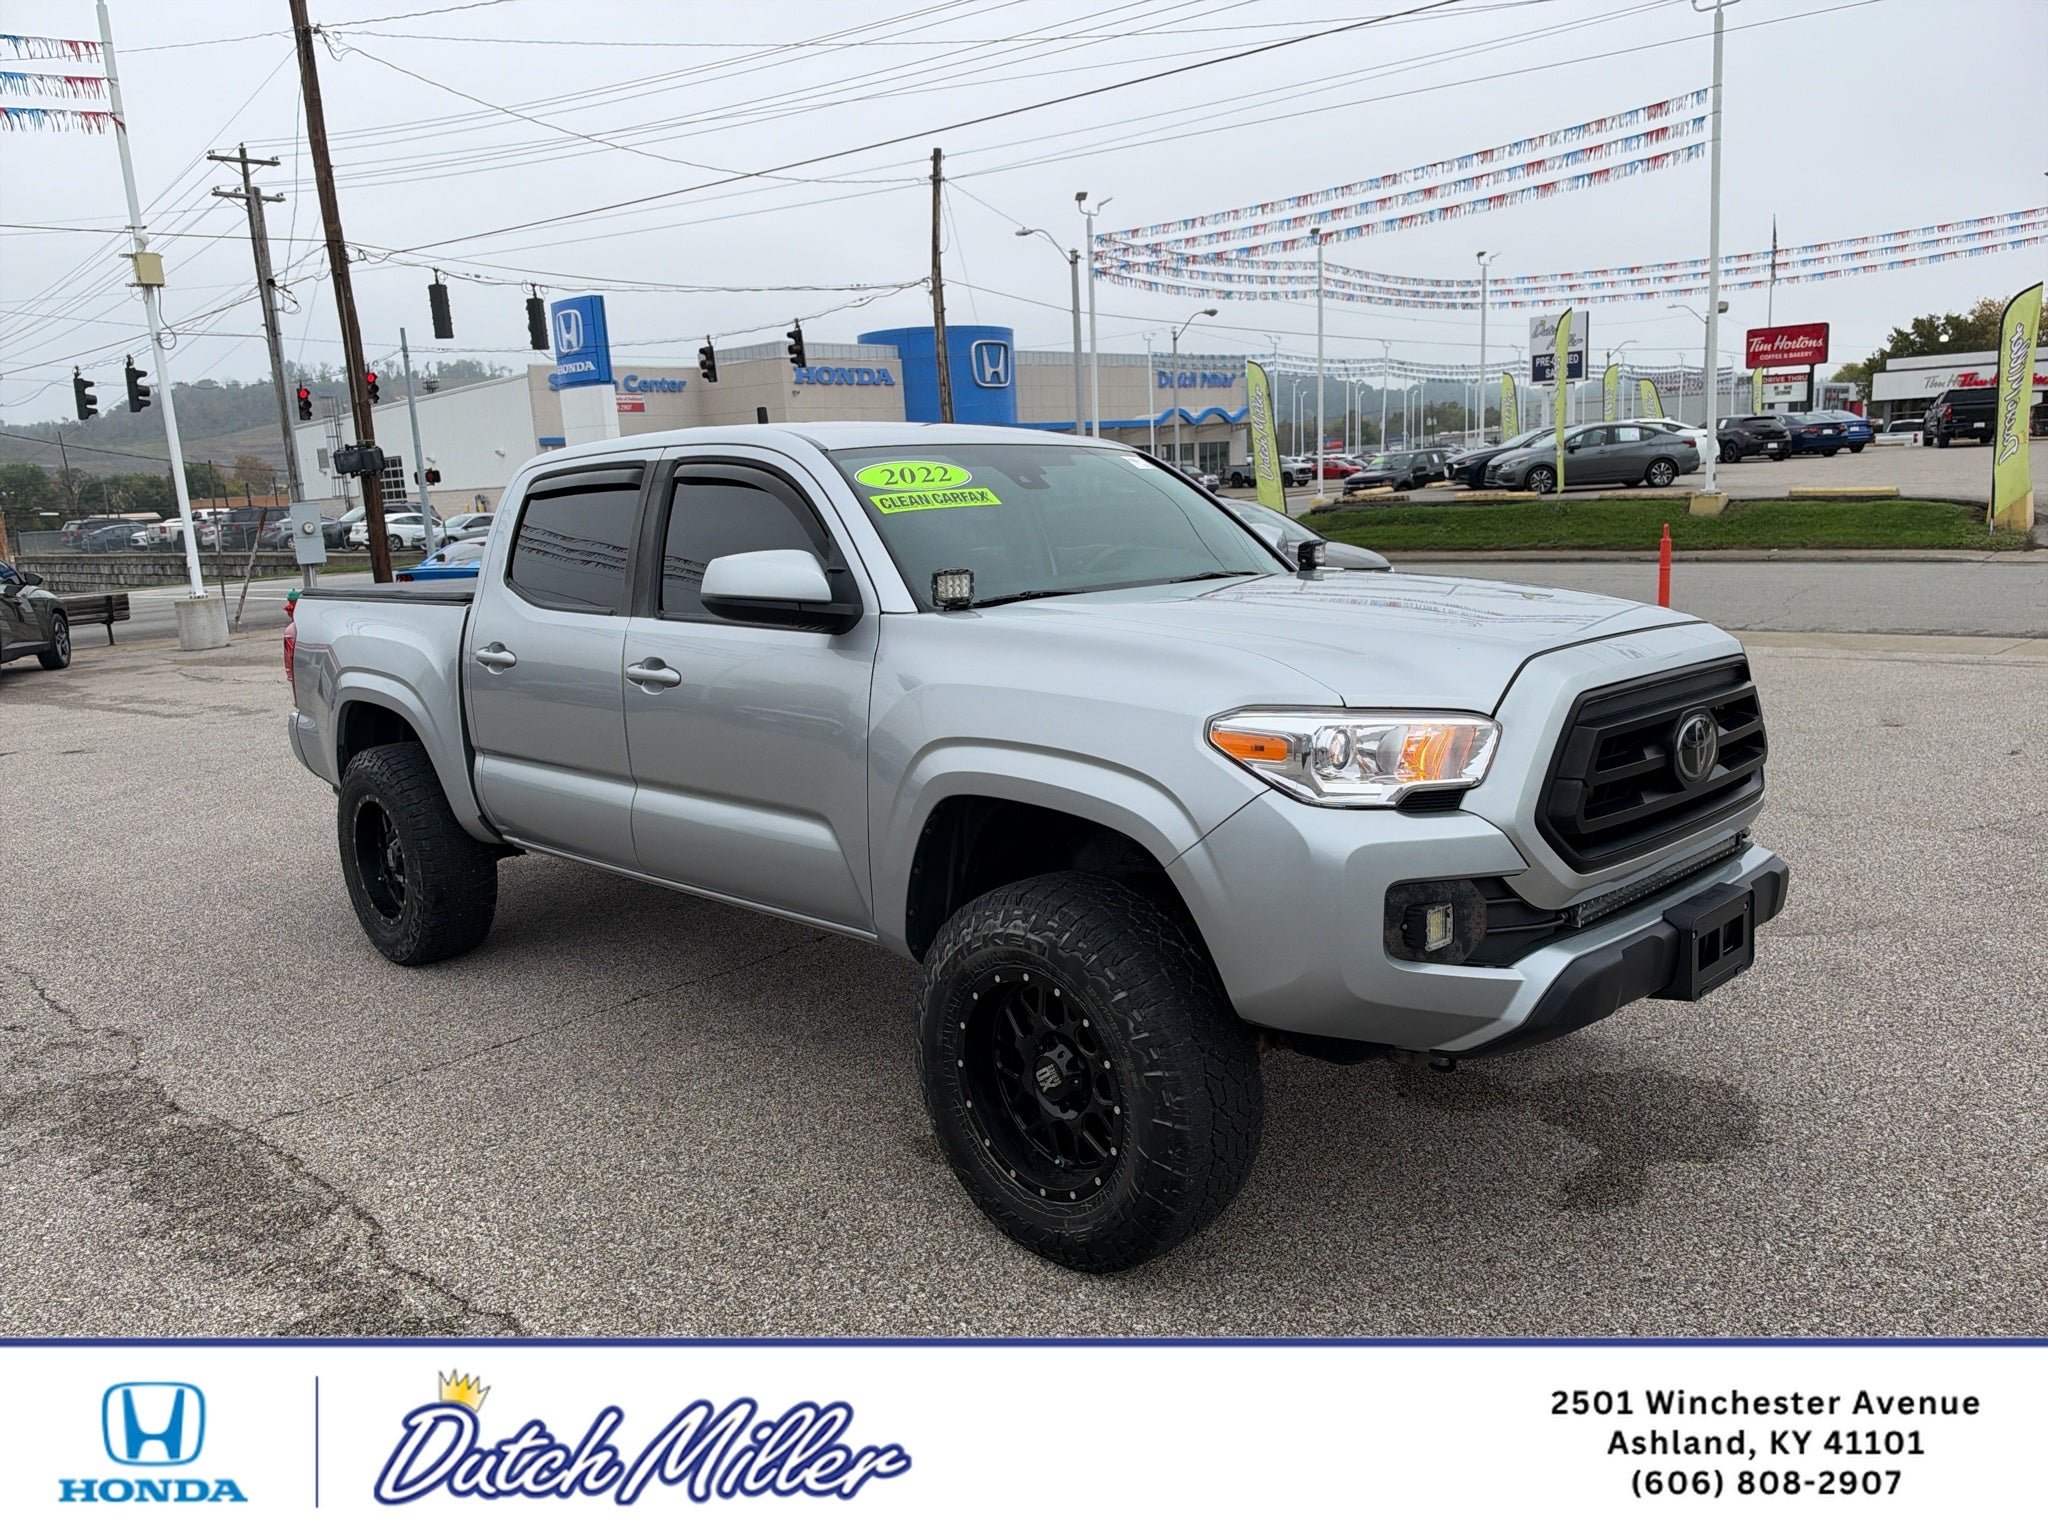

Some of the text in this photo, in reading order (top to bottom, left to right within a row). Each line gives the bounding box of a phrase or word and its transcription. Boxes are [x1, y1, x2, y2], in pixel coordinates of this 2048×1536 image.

[1748, 334, 1823, 353] Tim Hortons
[1760, 353, 1783, 361] COFFEE
[1788, 351, 1813, 359] BAKERY
[2004, 322, 2031, 401] Miller
[557, 361, 596, 375] HONDA
[793, 365, 896, 386] HONDA
[623, 374, 687, 392] Center
[1763, 374, 1809, 384] DRIVE THRU
[879, 466, 952, 486] 2022
[879, 488, 989, 510] CLEAN CARFAX
